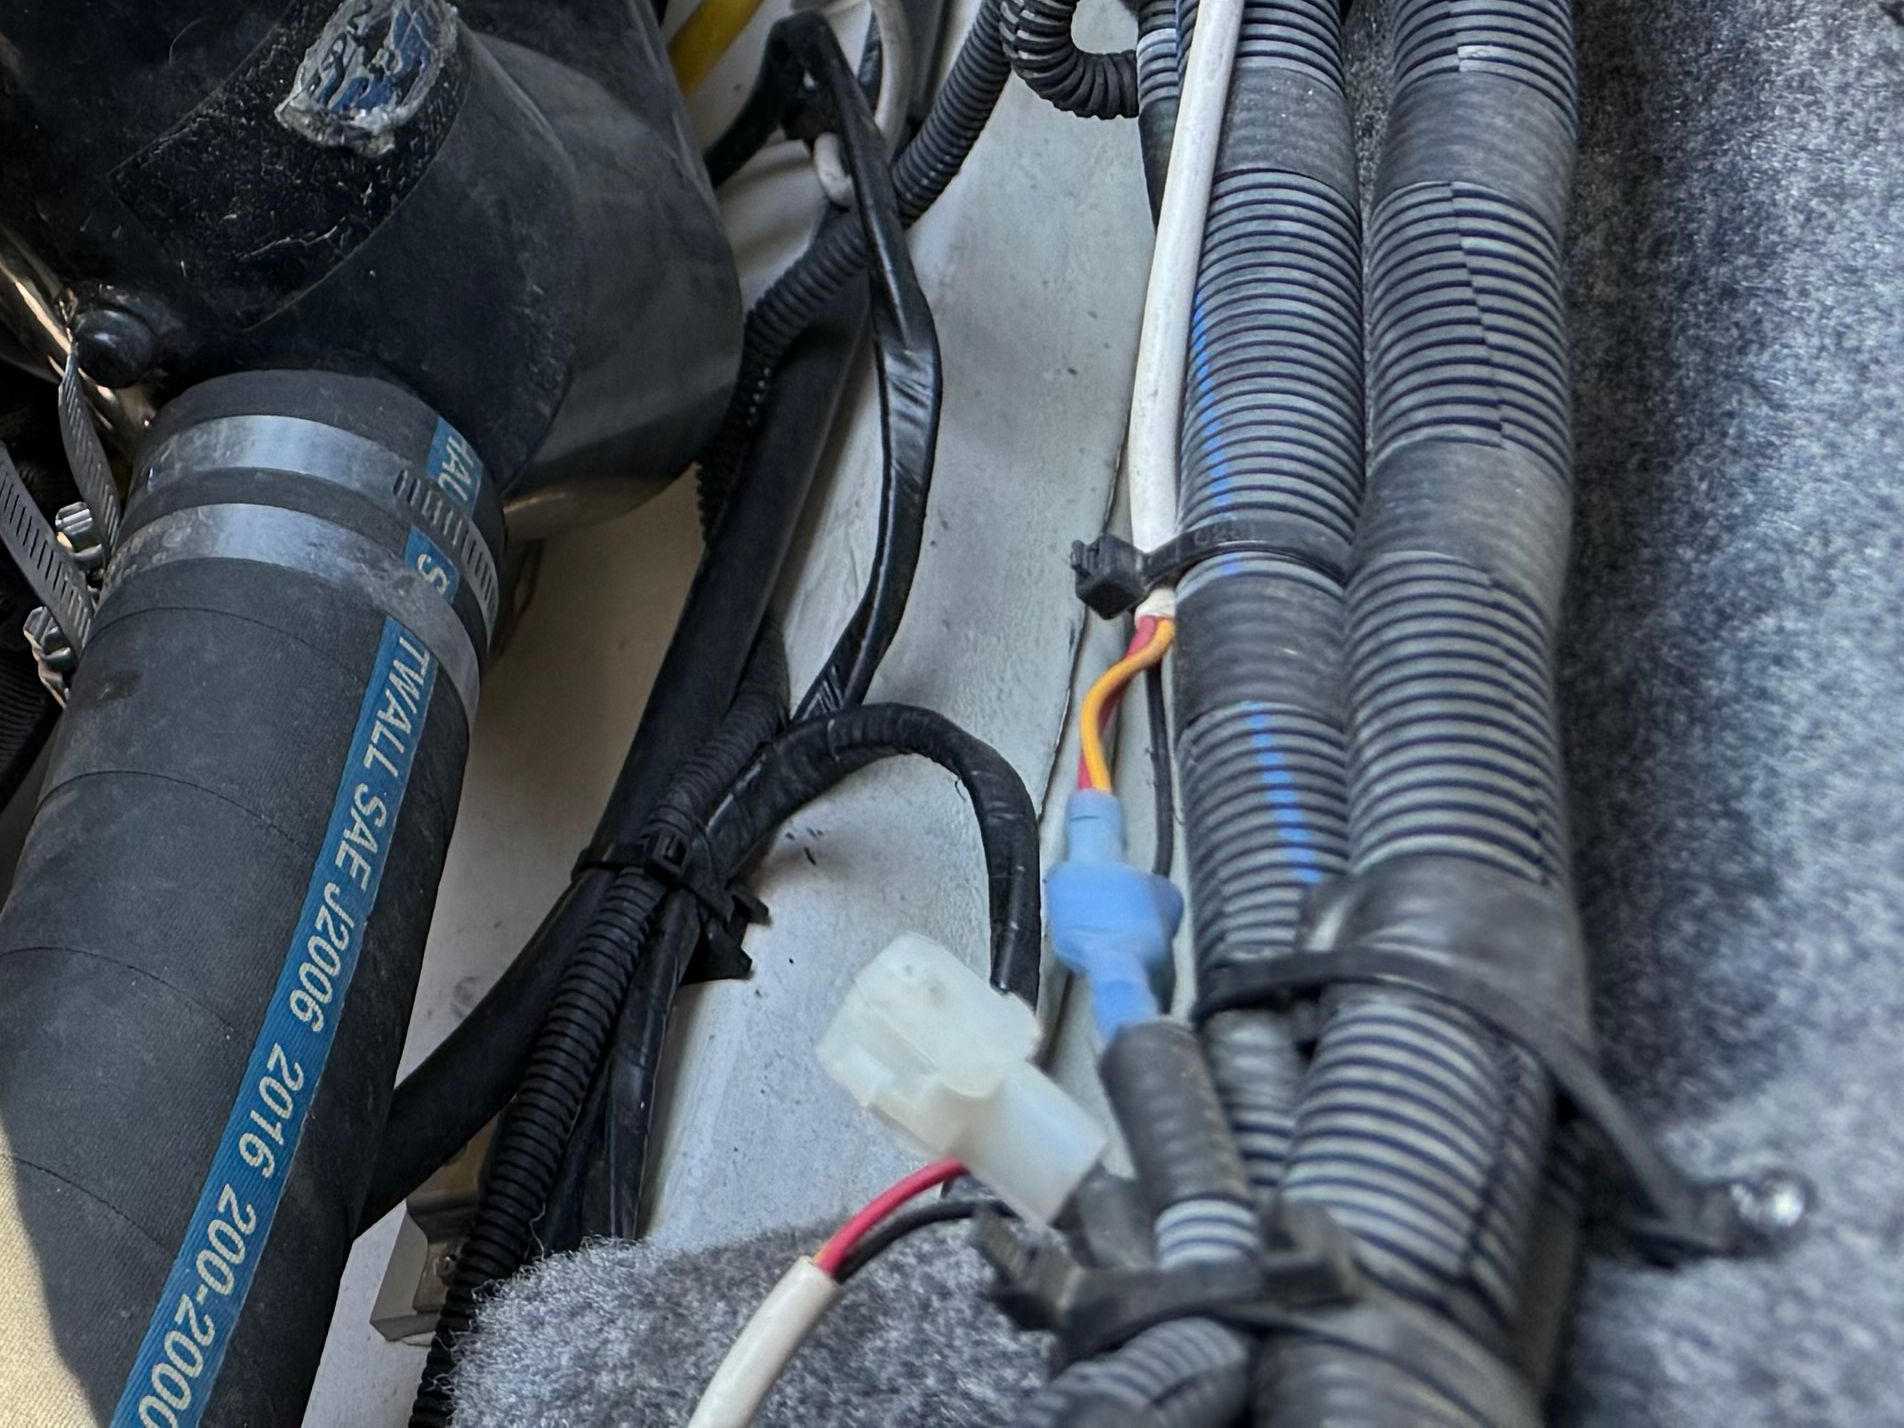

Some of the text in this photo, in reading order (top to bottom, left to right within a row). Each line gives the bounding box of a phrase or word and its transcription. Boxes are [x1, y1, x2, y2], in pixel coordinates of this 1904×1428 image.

[333, 781, 390, 892] SAE
[285, 880, 359, 1033] J2006
[232, 1042, 308, 1180] 2016
[132, 1182, 261, 1428] 200-2000
